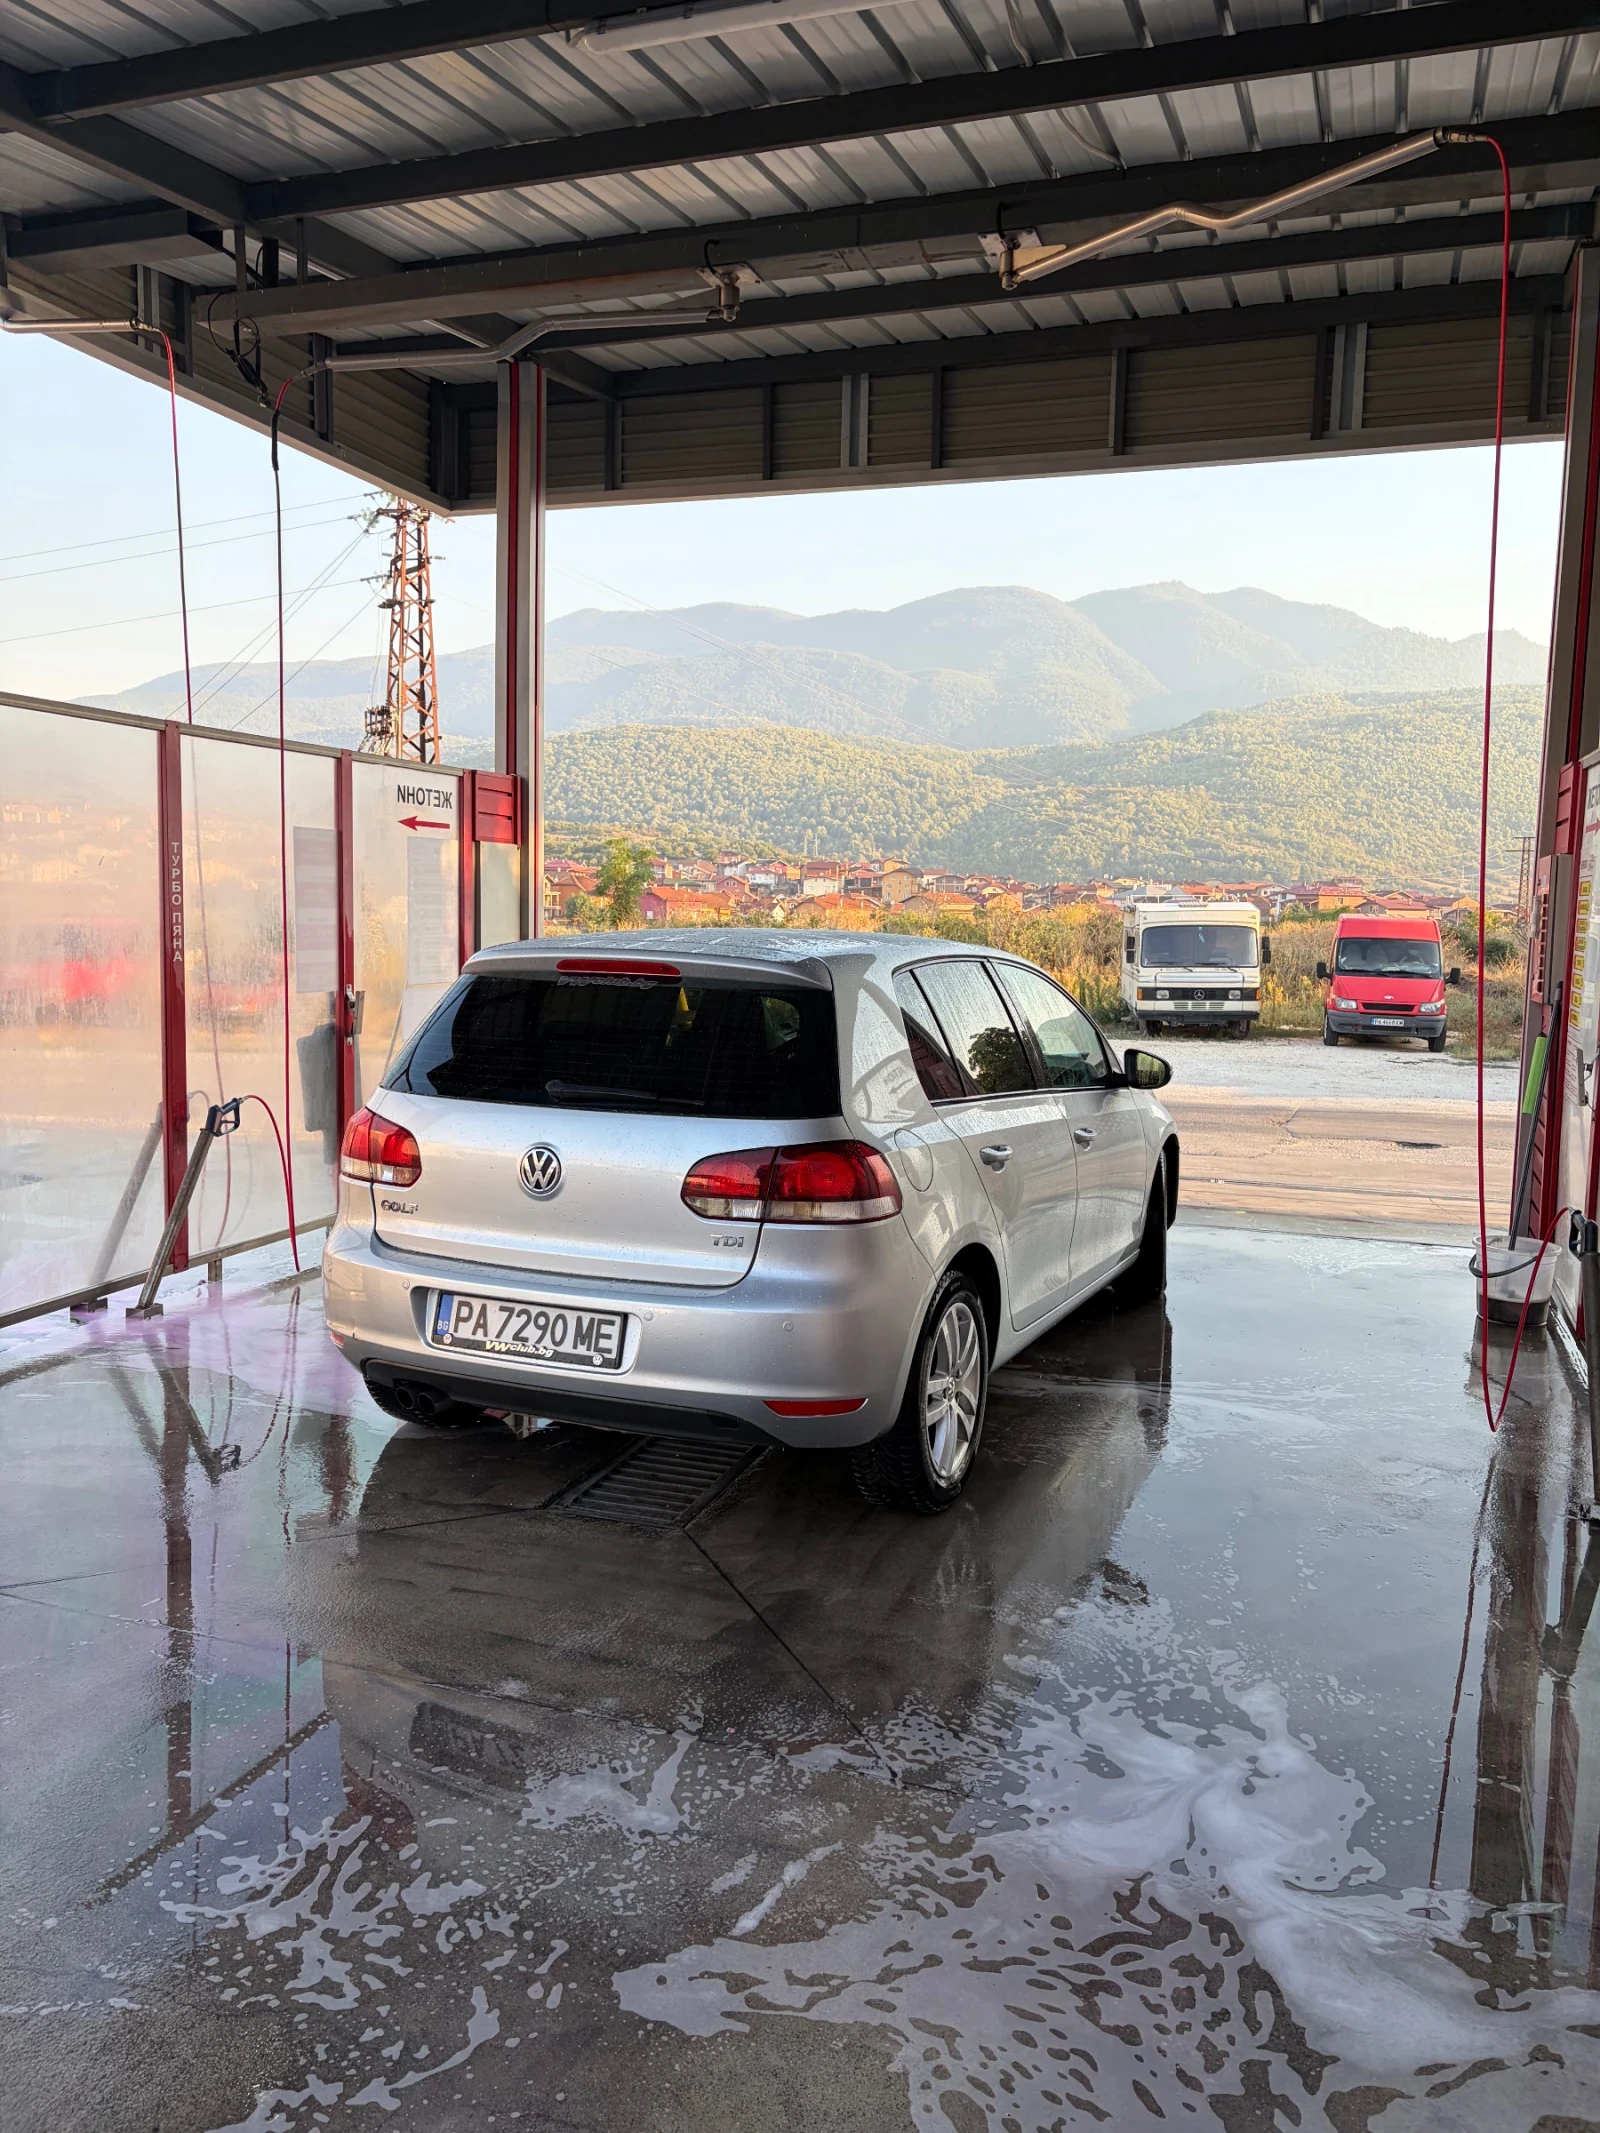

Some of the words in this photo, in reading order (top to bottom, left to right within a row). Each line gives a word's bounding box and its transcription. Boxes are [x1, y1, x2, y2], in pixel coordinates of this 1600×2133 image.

[171, 842, 182, 906] ТУРБО
[172, 912, 183, 962] ПЯНА
[381, 1199, 419, 1214] GOLF
[710, 1234, 745, 1248] TDI
[436, 1320, 449, 1331] BG
[453, 1300, 488, 1338] PA
[494, 1306, 568, 1347] 7290
[572, 1316, 616, 1354] ME
[485, 1340, 555, 1358] VWclub.bg
